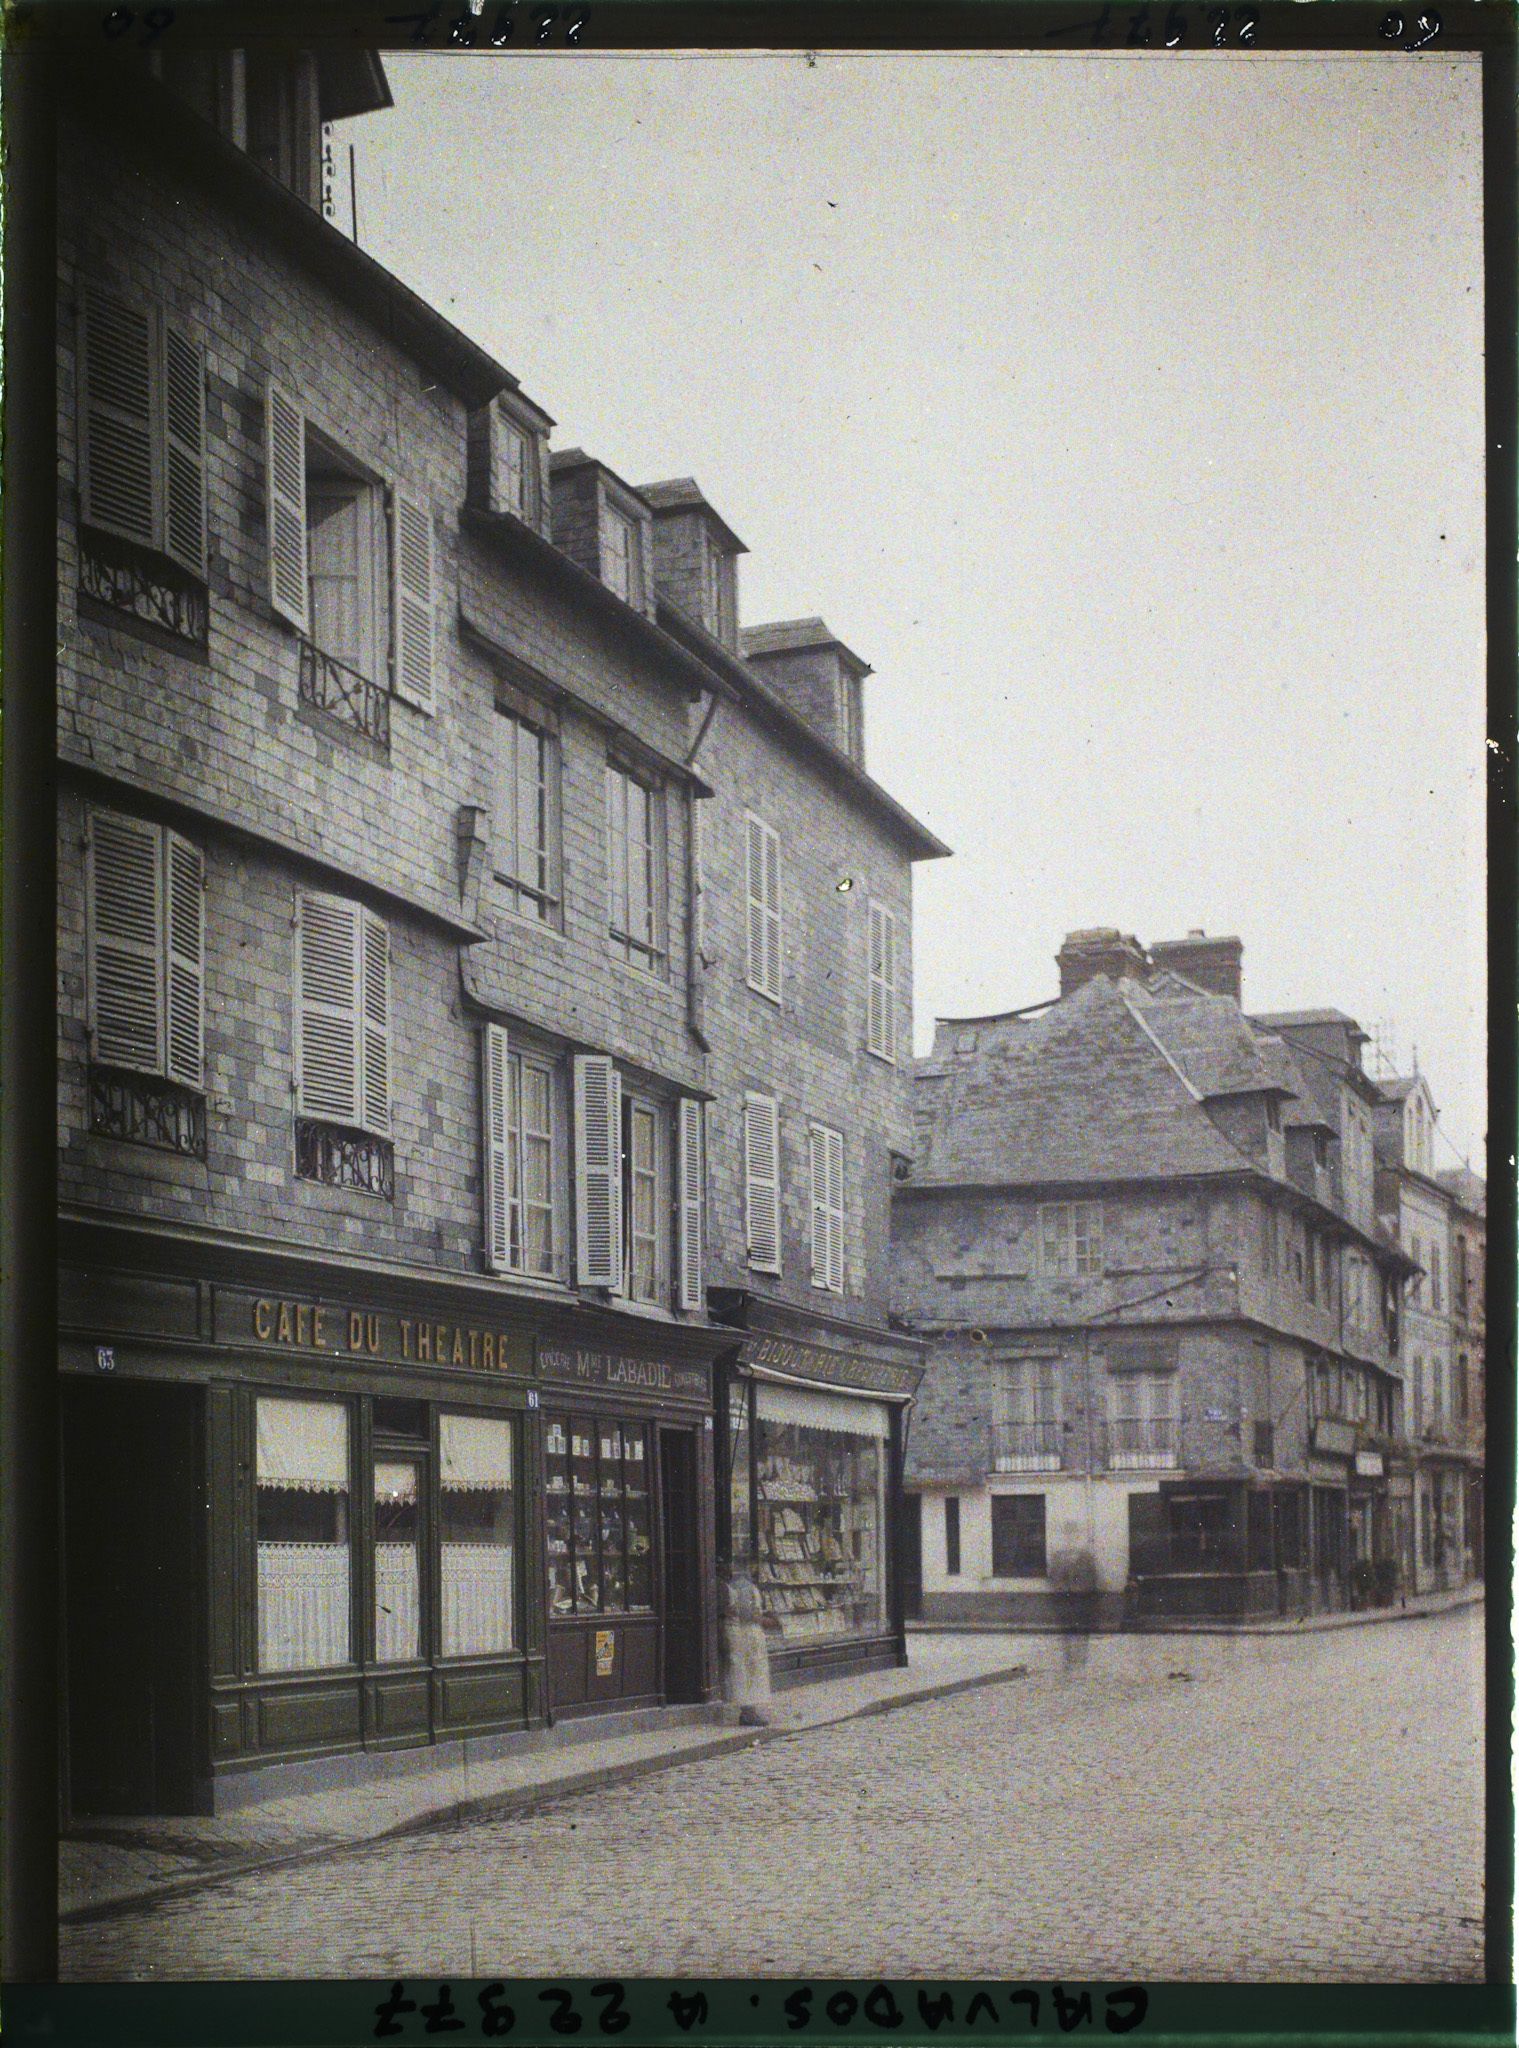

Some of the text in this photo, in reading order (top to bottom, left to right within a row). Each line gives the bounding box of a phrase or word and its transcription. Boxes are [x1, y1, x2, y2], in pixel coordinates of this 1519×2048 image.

[350, 1311, 380, 1352] DU
[401, 1319, 508, 1370] THEATRE
[97, 1348, 115, 1370] 63
[607, 1355, 672, 1389] LABADIE
[528, 1391, 539, 1408] 61
[667, 1991, 708, 2031] A
